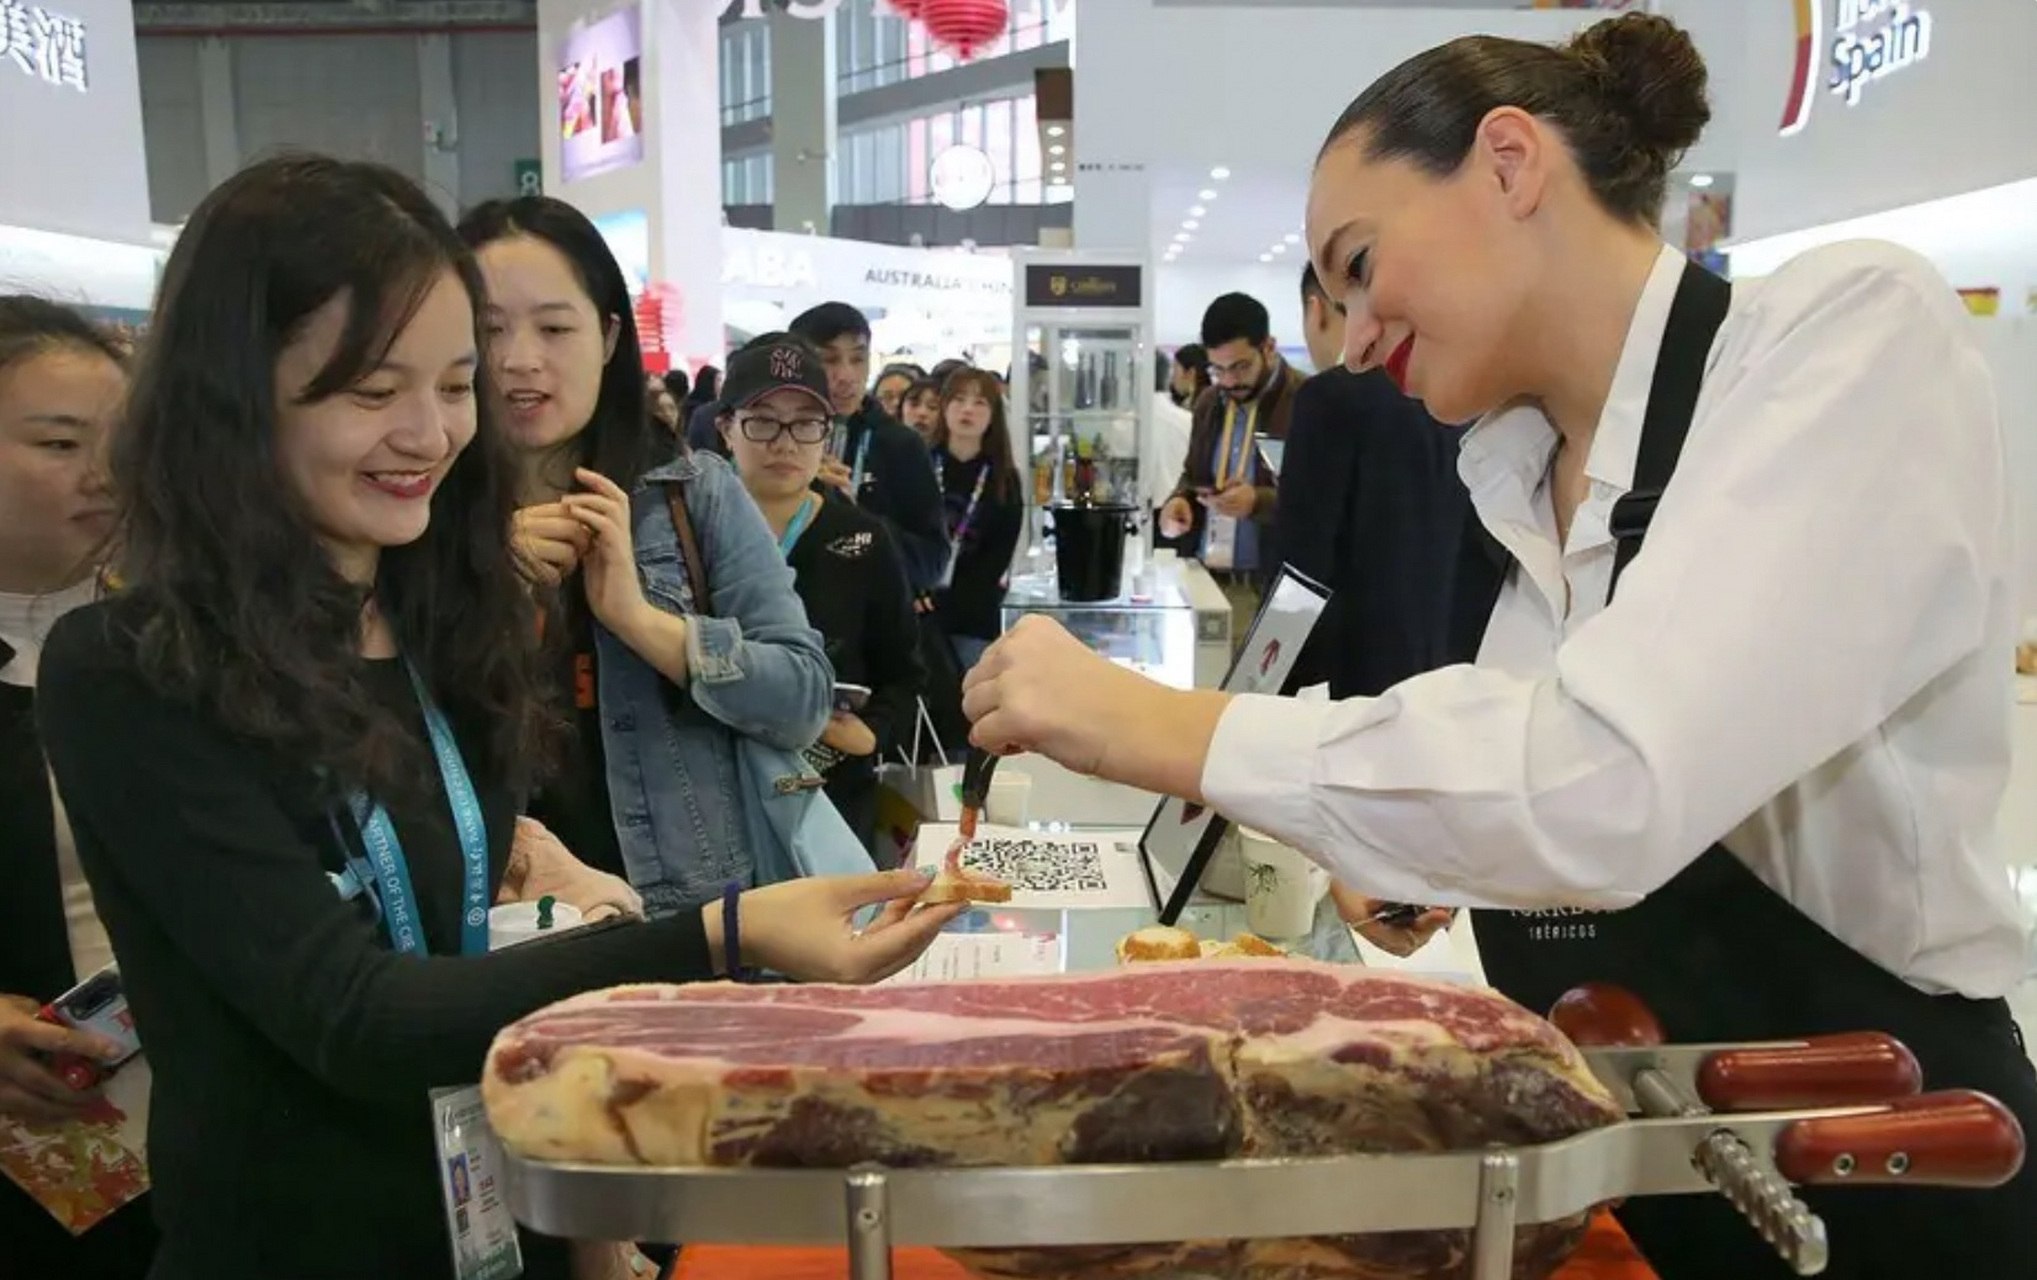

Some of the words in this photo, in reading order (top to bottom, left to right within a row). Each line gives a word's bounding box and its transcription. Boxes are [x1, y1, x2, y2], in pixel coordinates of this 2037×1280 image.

[1828, 11, 1930, 105] Spain
[865, 268, 961, 289] AUSTRALIA
[368, 818, 396, 876] ARTNER
[386, 877, 402, 895] OF
[392, 896, 409, 925] THE
[1528, 923, 1597, 940] IBÉRICOS
